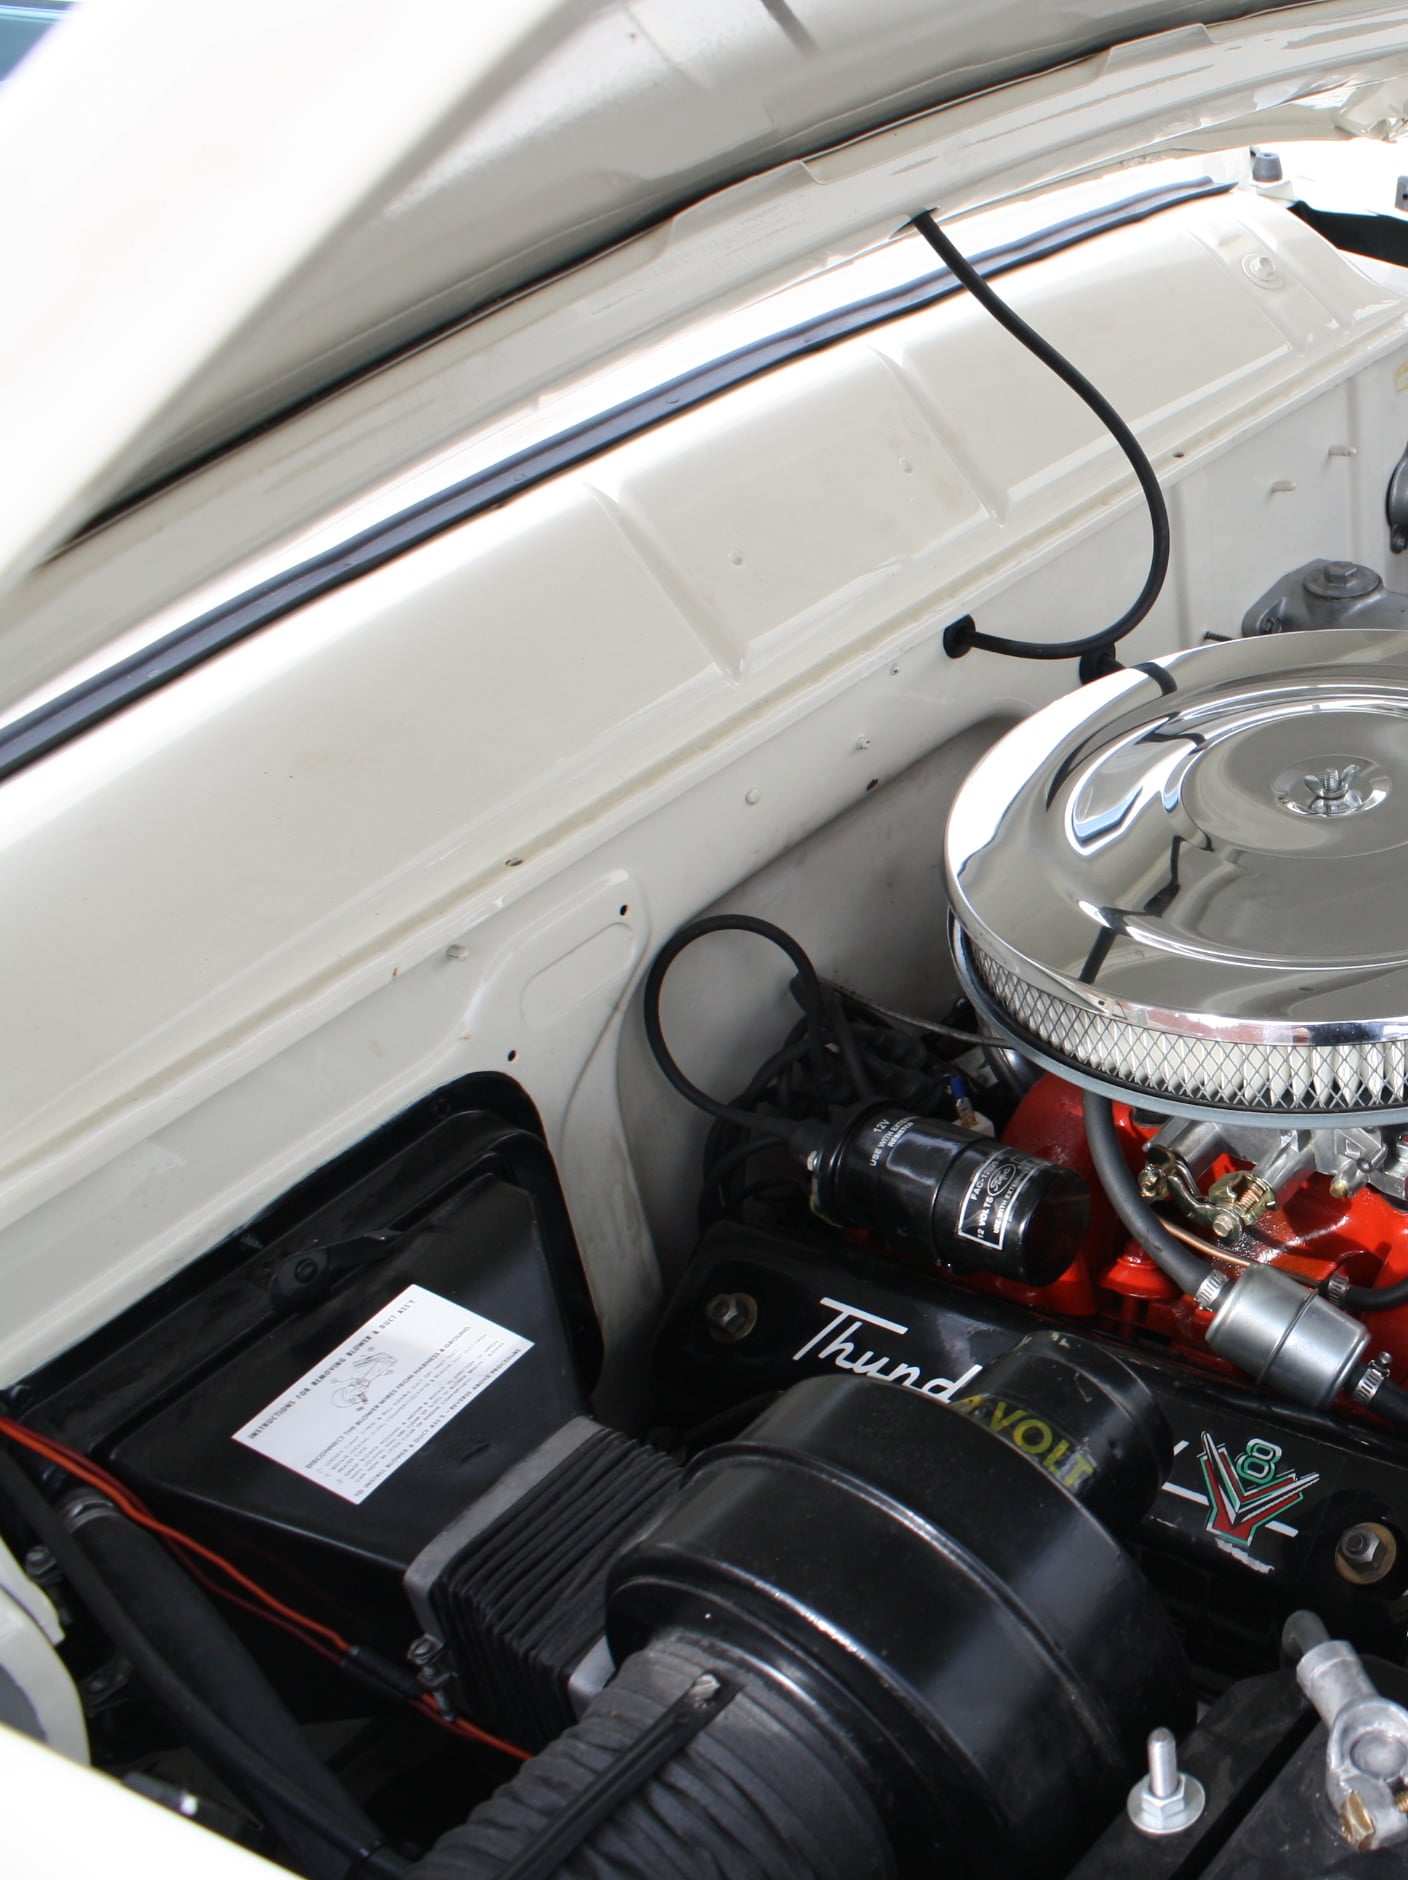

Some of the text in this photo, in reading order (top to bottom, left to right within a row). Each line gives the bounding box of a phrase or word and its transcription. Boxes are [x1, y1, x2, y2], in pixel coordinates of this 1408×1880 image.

[869, 1150, 882, 1167] USE
[979, 1195, 995, 1226] VOLTS
[792, 1297, 983, 1405] Thund
[990, 1401, 1094, 1488] VOLT
